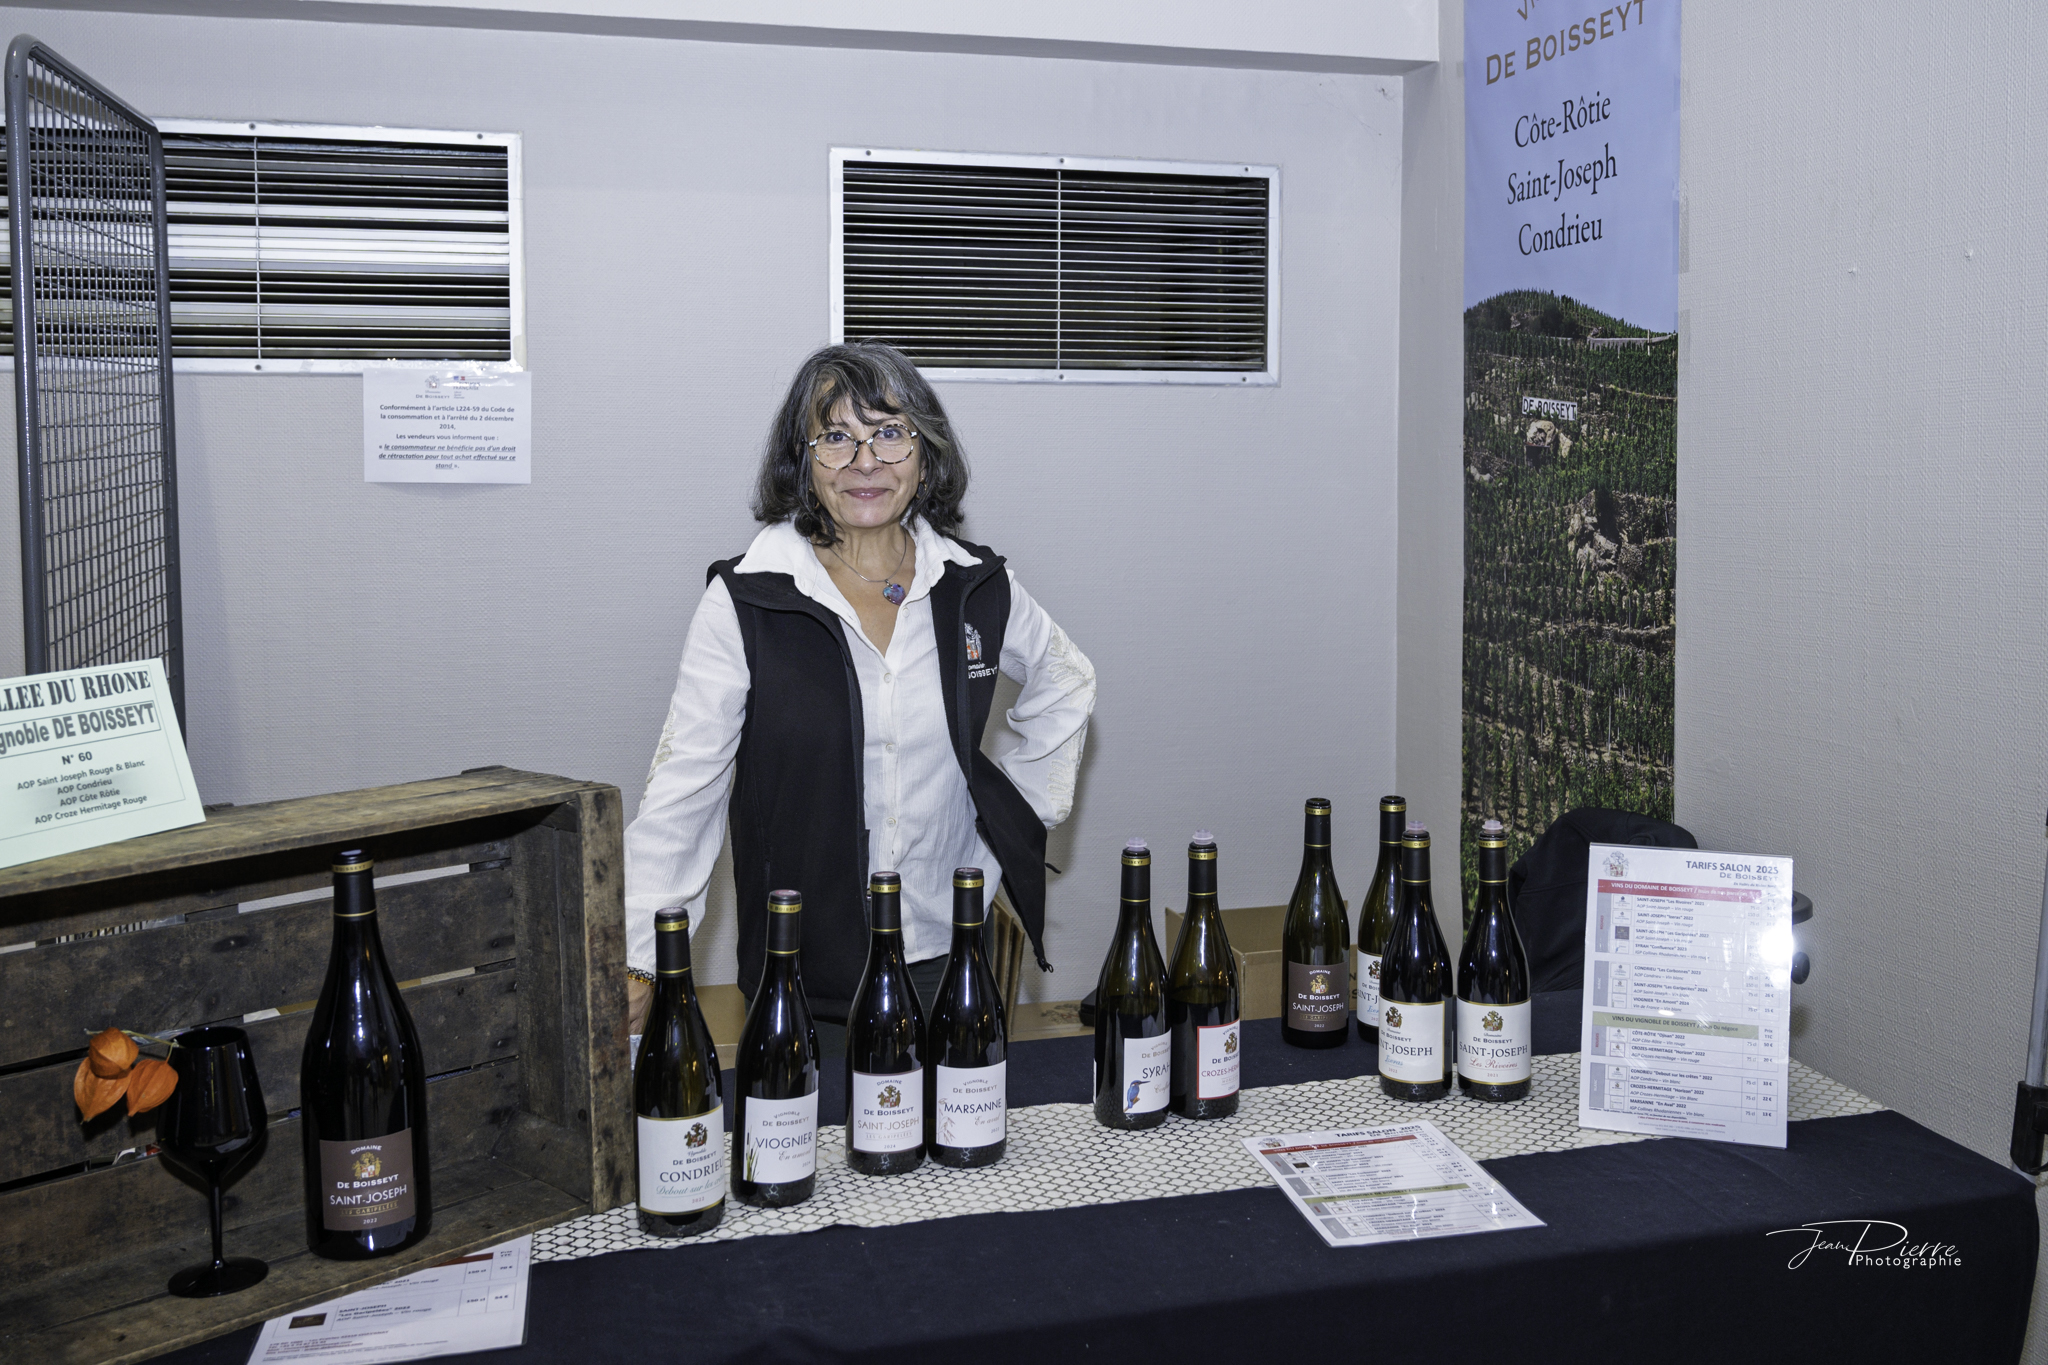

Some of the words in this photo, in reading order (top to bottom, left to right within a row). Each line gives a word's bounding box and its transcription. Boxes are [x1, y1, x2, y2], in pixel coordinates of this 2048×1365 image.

[1486, 51, 1516, 85] DE
[1526, 0, 1646, 70] BOISSEYT
[1515, 91, 1612, 148] Côte-Rôtie
[1507, 142, 1618, 205] Saint-Joseph
[1519, 212, 1603, 256] Condrieu
[1538, 400, 1576, 420] BOISSEYT
[47, 678, 77, 706] DU
[81, 671, 151, 700] RHONE
[52, 716, 76, 739] DE
[78, 703, 155, 735] BOISSEYT
[78, 751, 93, 762] 60
[17, 781, 35, 790] AOP
[37, 776, 58, 787] Saint
[60, 771, 87, 782] Joseph
[89, 766, 114, 776] Rouge
[125, 760, 145, 769] Blanc
[57, 785, 75, 795] AOP
[76, 779, 113, 792] Condrieu
[60, 797, 77, 807] AOP
[79, 793, 98, 803] Côte
[100, 789, 121, 799] Rôtie
[35, 814, 53, 824] AOP
[55, 810, 78, 820] Croze
[80, 801, 121, 815] Hermitage
[123, 795, 148, 805] Rouge
[1686, 860, 1718, 871] TARIFS
[1720, 863, 1752, 873] SALON
[1756, 865, 1779, 874] 2025
[1293, 1002, 1344, 1013] SAINT-JOSEPH
[1671, 1020, 1696, 1028] BOISSEYT
[1386, 1033, 1412, 1042] BOISSEYT
[1459, 1041, 1528, 1060] SAINT-JOSEPH
[876, 1079, 902, 1087] DOMAINE
[966, 1085, 997, 1094] BOISSEYT
[877, 1106, 915, 1116] BOISSEYT
[944, 1098, 1002, 1115] MARSANNE
[776, 1116, 810, 1127] BOISSEYT
[858, 1116, 920, 1131] SAINT-JOSEPH
[756, 1132, 813, 1150] VIOGNIER
[350, 1145, 383, 1155] DOMAINE
[686, 1151, 717, 1165] BOISSEYT
[353, 1174, 399, 1188] BOISSEYT
[330, 1184, 408, 1205] SAINT-JOSEPH
[656, 1184, 688, 1196] Debout
